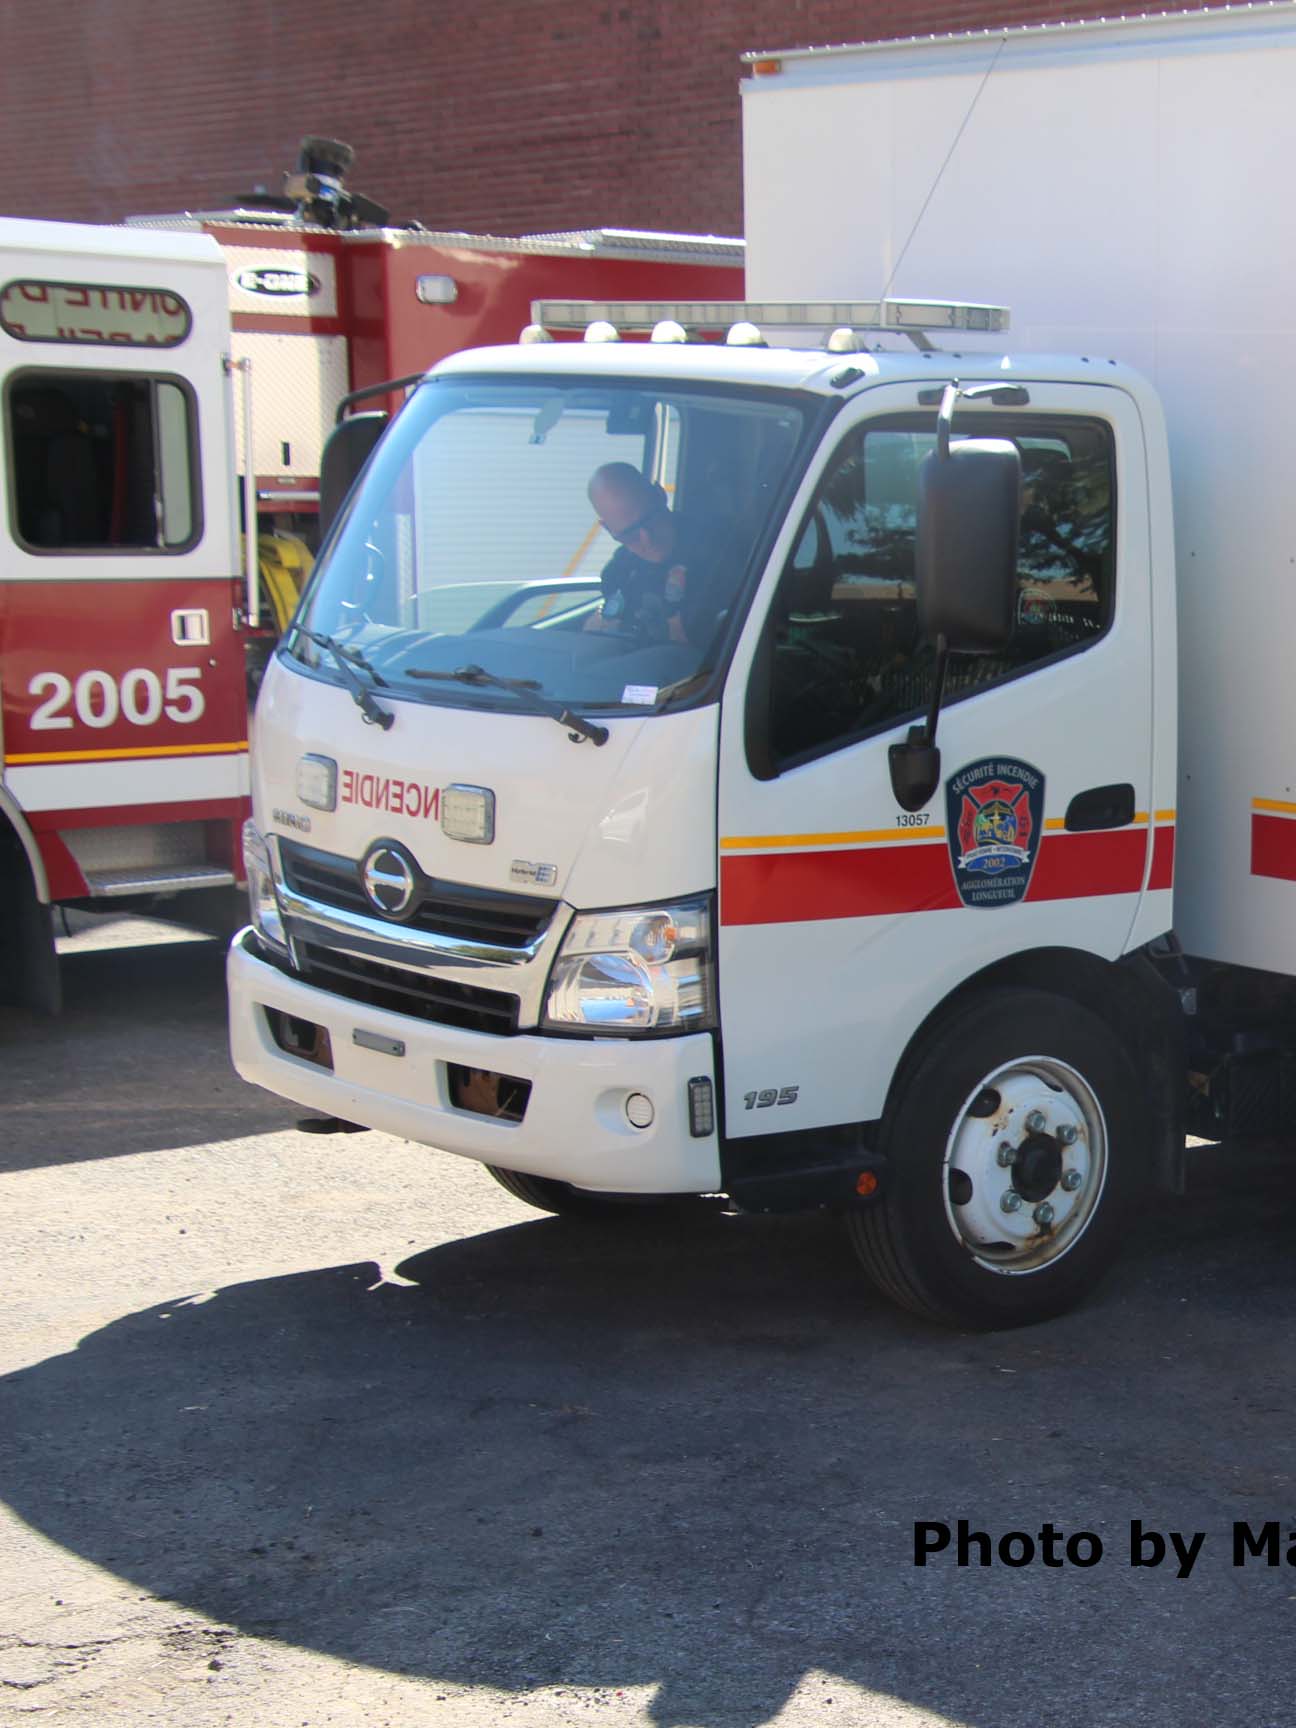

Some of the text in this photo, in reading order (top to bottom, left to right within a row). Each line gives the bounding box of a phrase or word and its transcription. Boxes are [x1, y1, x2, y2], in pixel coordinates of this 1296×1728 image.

[28, 667, 206, 731] 2005
[952, 762, 1040, 795] SÉCURITÉ INCENDIE
[896, 813, 930, 828] 13057
[743, 1086, 800, 1111] 195
